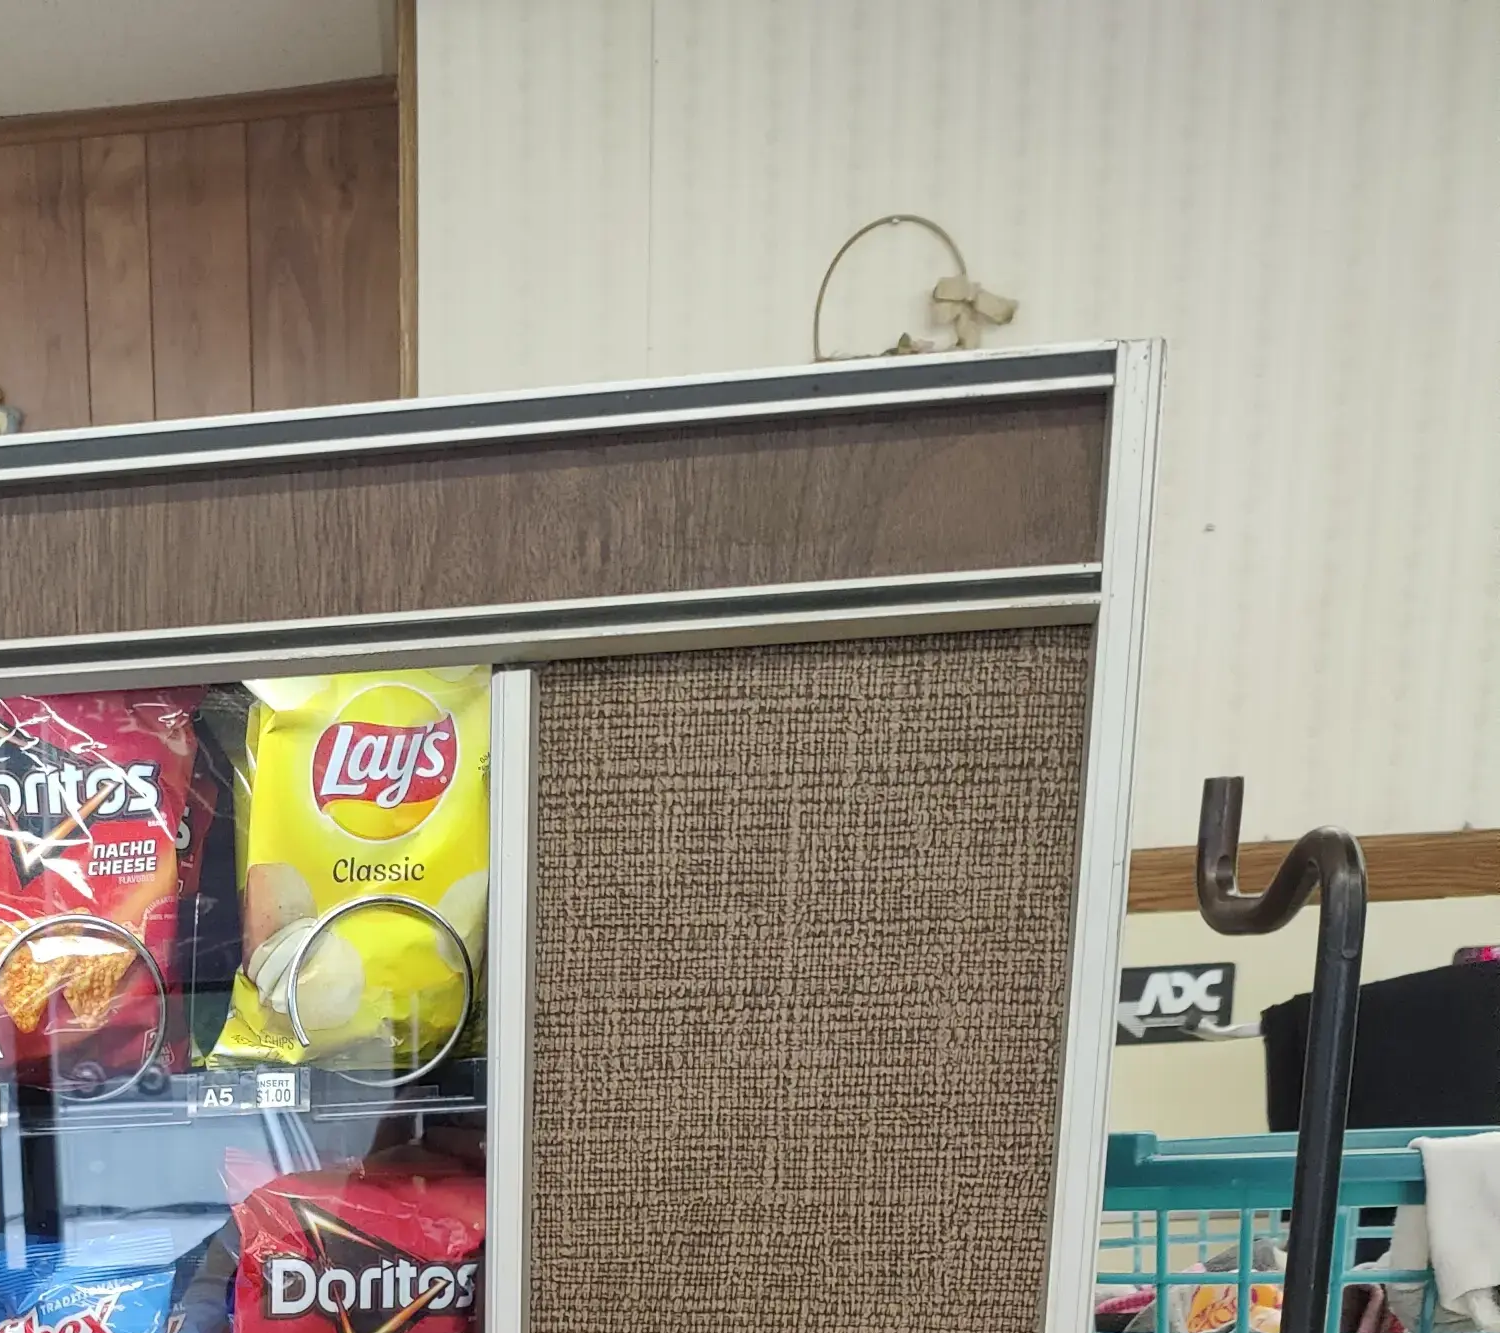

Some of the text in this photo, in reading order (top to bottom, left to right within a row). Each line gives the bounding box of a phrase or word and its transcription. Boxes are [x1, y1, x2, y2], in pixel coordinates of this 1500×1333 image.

[320, 721, 450, 809] Lay's
[92, 839, 156, 859] NACHO
[88, 856, 157, 877] CHEESE
[332, 856, 425, 883] Classic
[1136, 969, 1224, 1016] ADC
[203, 1087, 233, 1107] A5
[271, 1259, 479, 1315] Doritos
